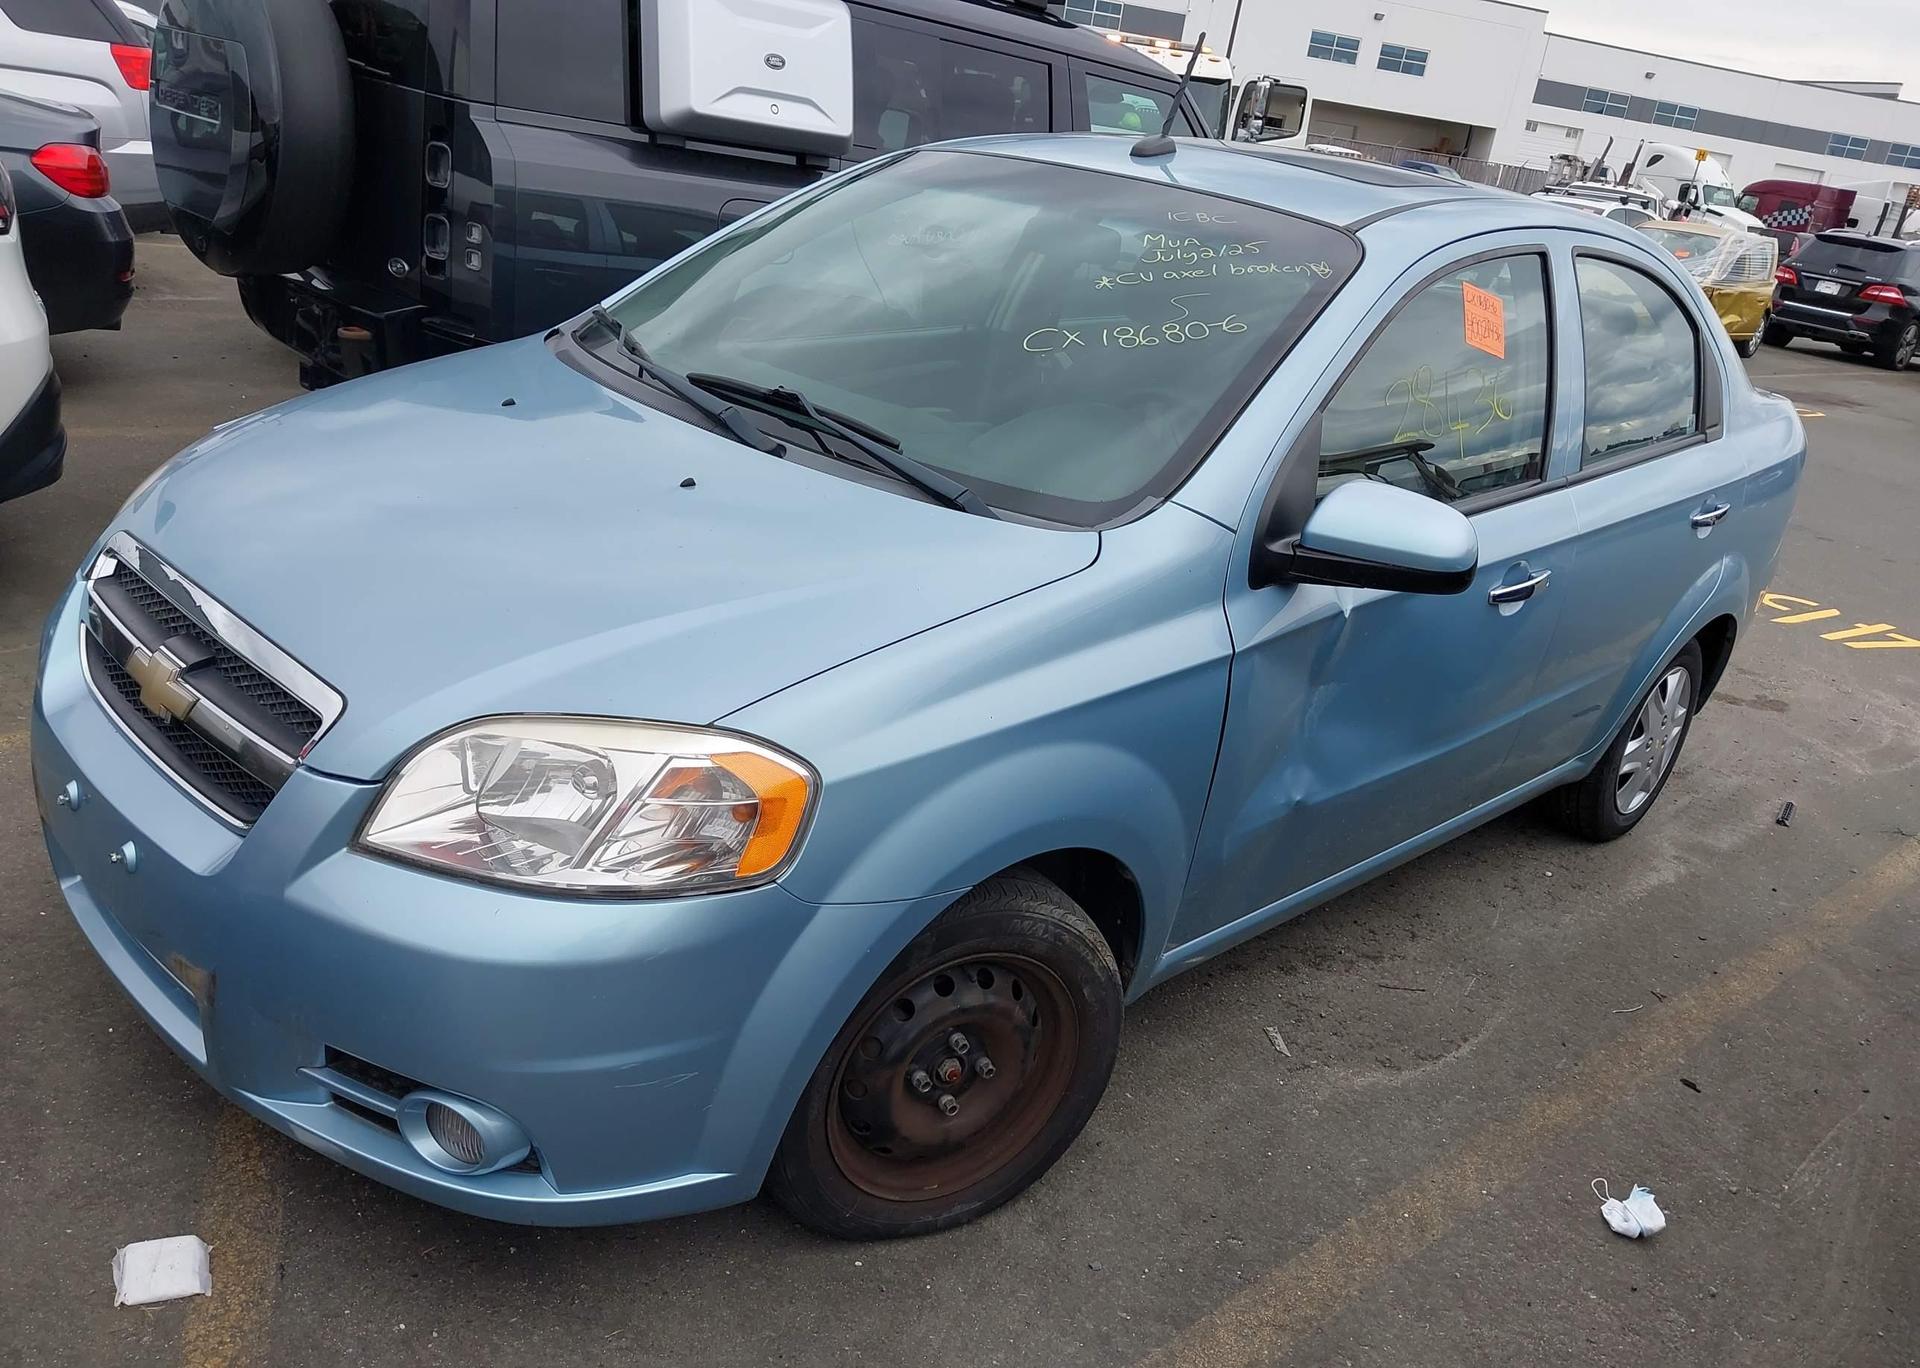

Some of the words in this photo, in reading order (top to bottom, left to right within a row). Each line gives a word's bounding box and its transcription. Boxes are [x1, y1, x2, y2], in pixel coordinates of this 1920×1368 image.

[1163, 263, 1218, 280] axel
[1023, 328, 1086, 352] CX
[1102, 314, 1248, 348] 18680-6
